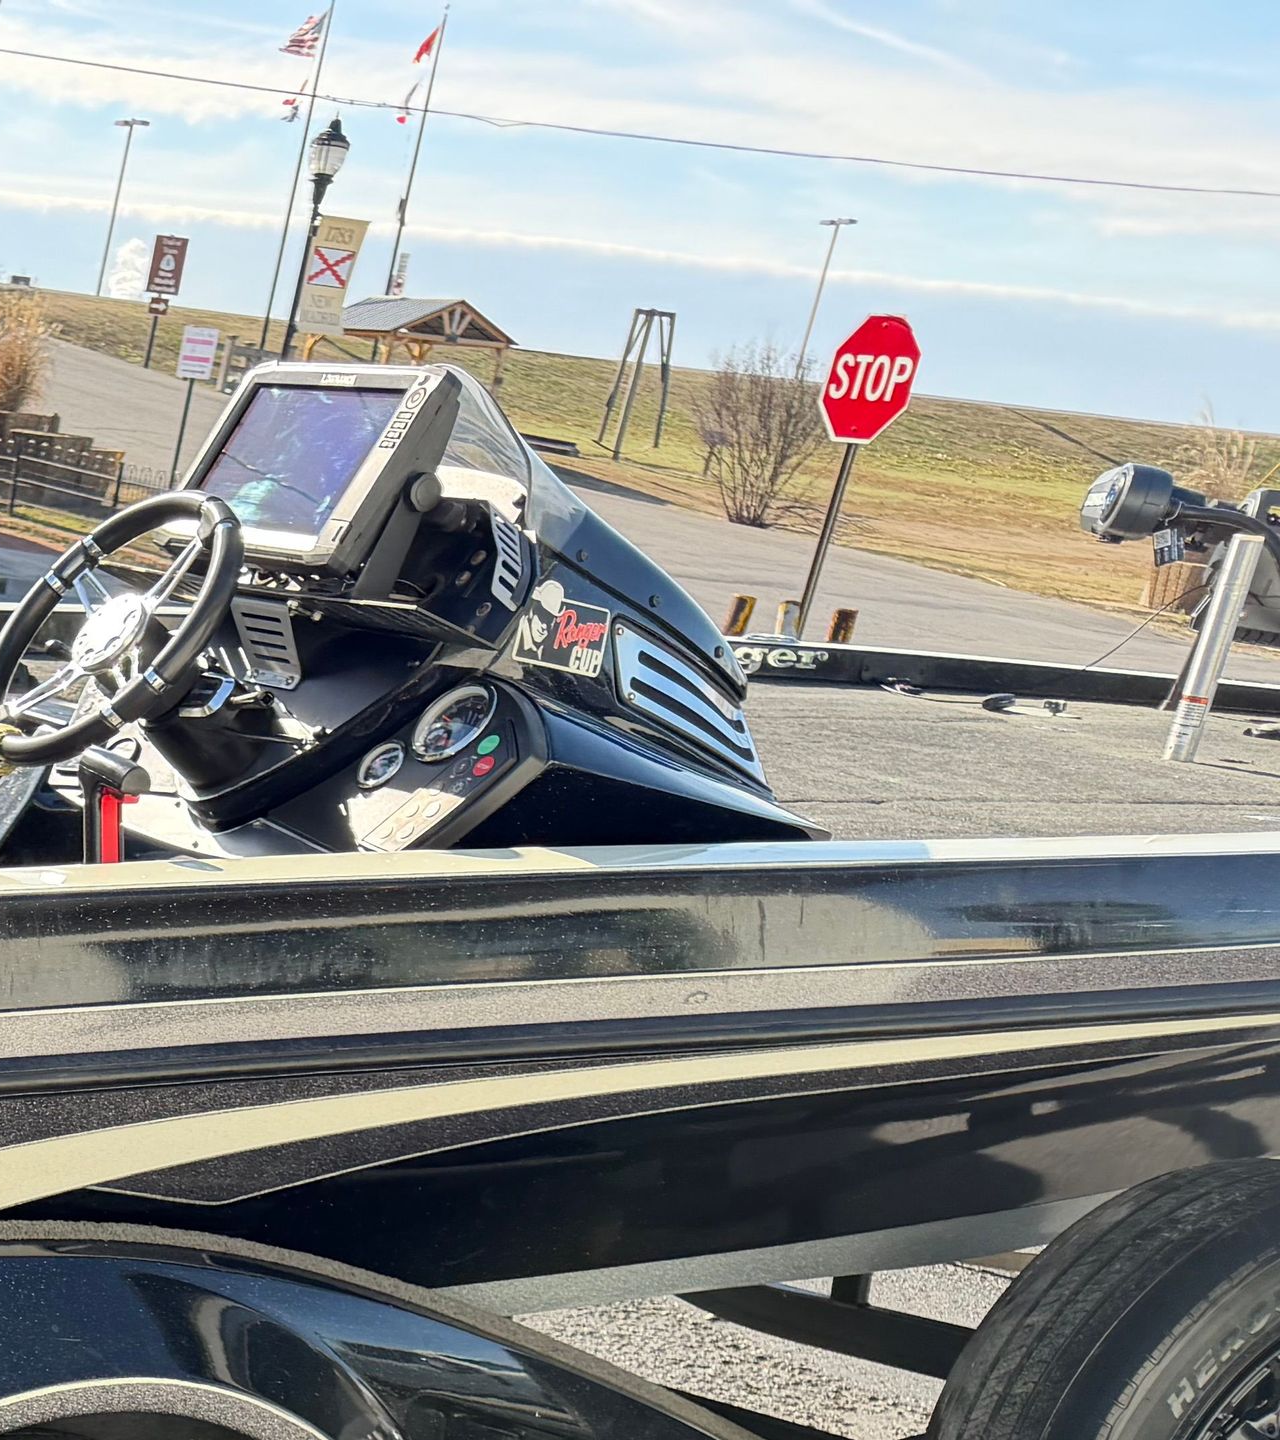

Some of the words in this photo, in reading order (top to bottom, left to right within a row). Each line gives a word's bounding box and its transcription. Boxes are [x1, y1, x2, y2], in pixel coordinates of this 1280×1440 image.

[829, 353, 914, 402] STOP
[553, 609, 608, 650] Ranger
[569, 645, 602, 674] CUP
[734, 646, 829, 675] ger
[1167, 1299, 1280, 1419] HERC
